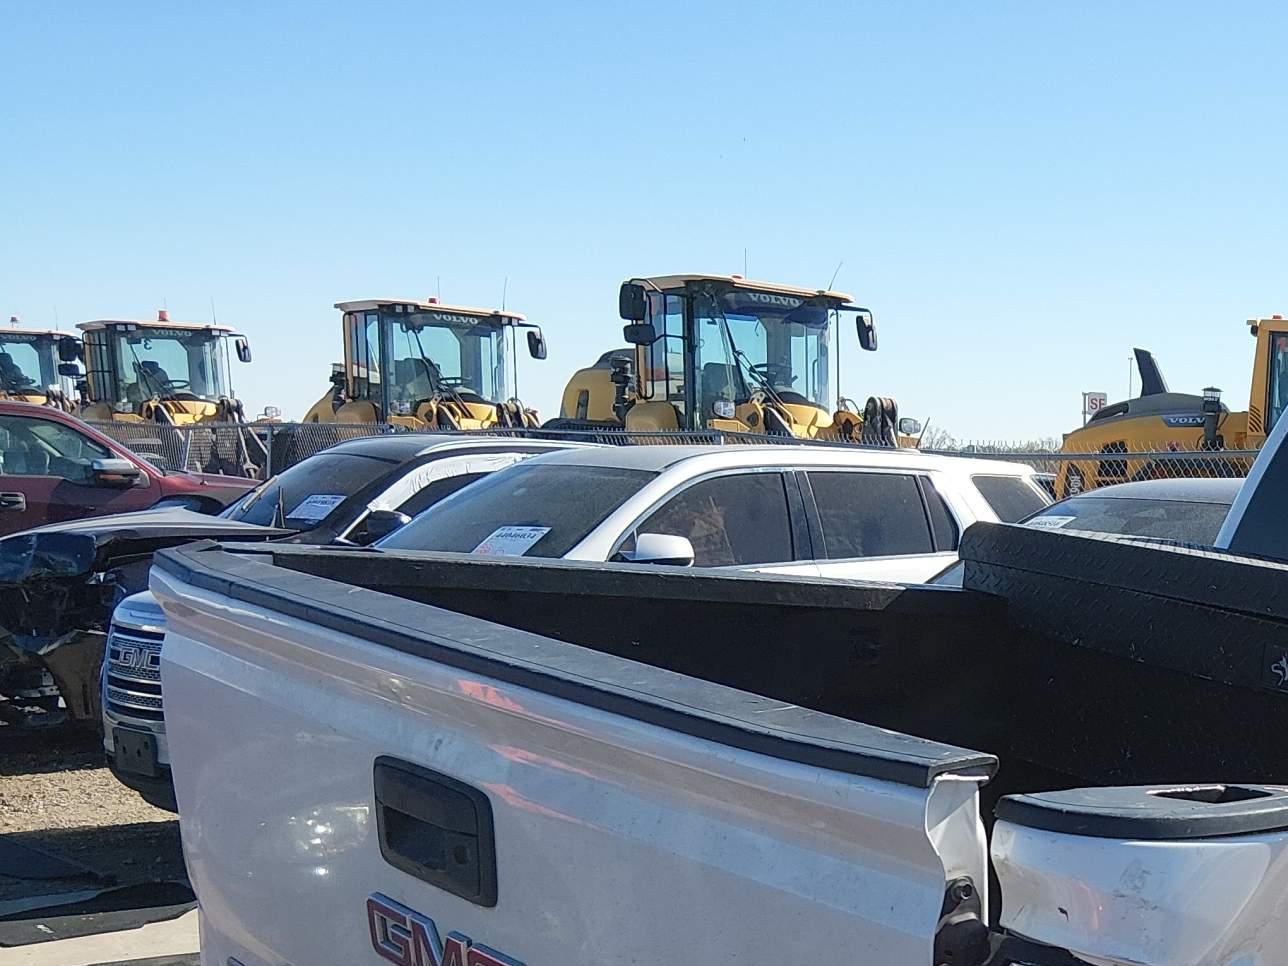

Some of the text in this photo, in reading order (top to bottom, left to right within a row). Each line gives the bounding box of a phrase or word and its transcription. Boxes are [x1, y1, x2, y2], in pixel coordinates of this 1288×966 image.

[748, 292, 801, 308] VOLVO
[433, 313, 479, 325] VOLVO
[151, 329, 192, 337] VOLVO
[1168, 416, 1206, 425] VOLV
[119, 647, 161, 671] GMC
